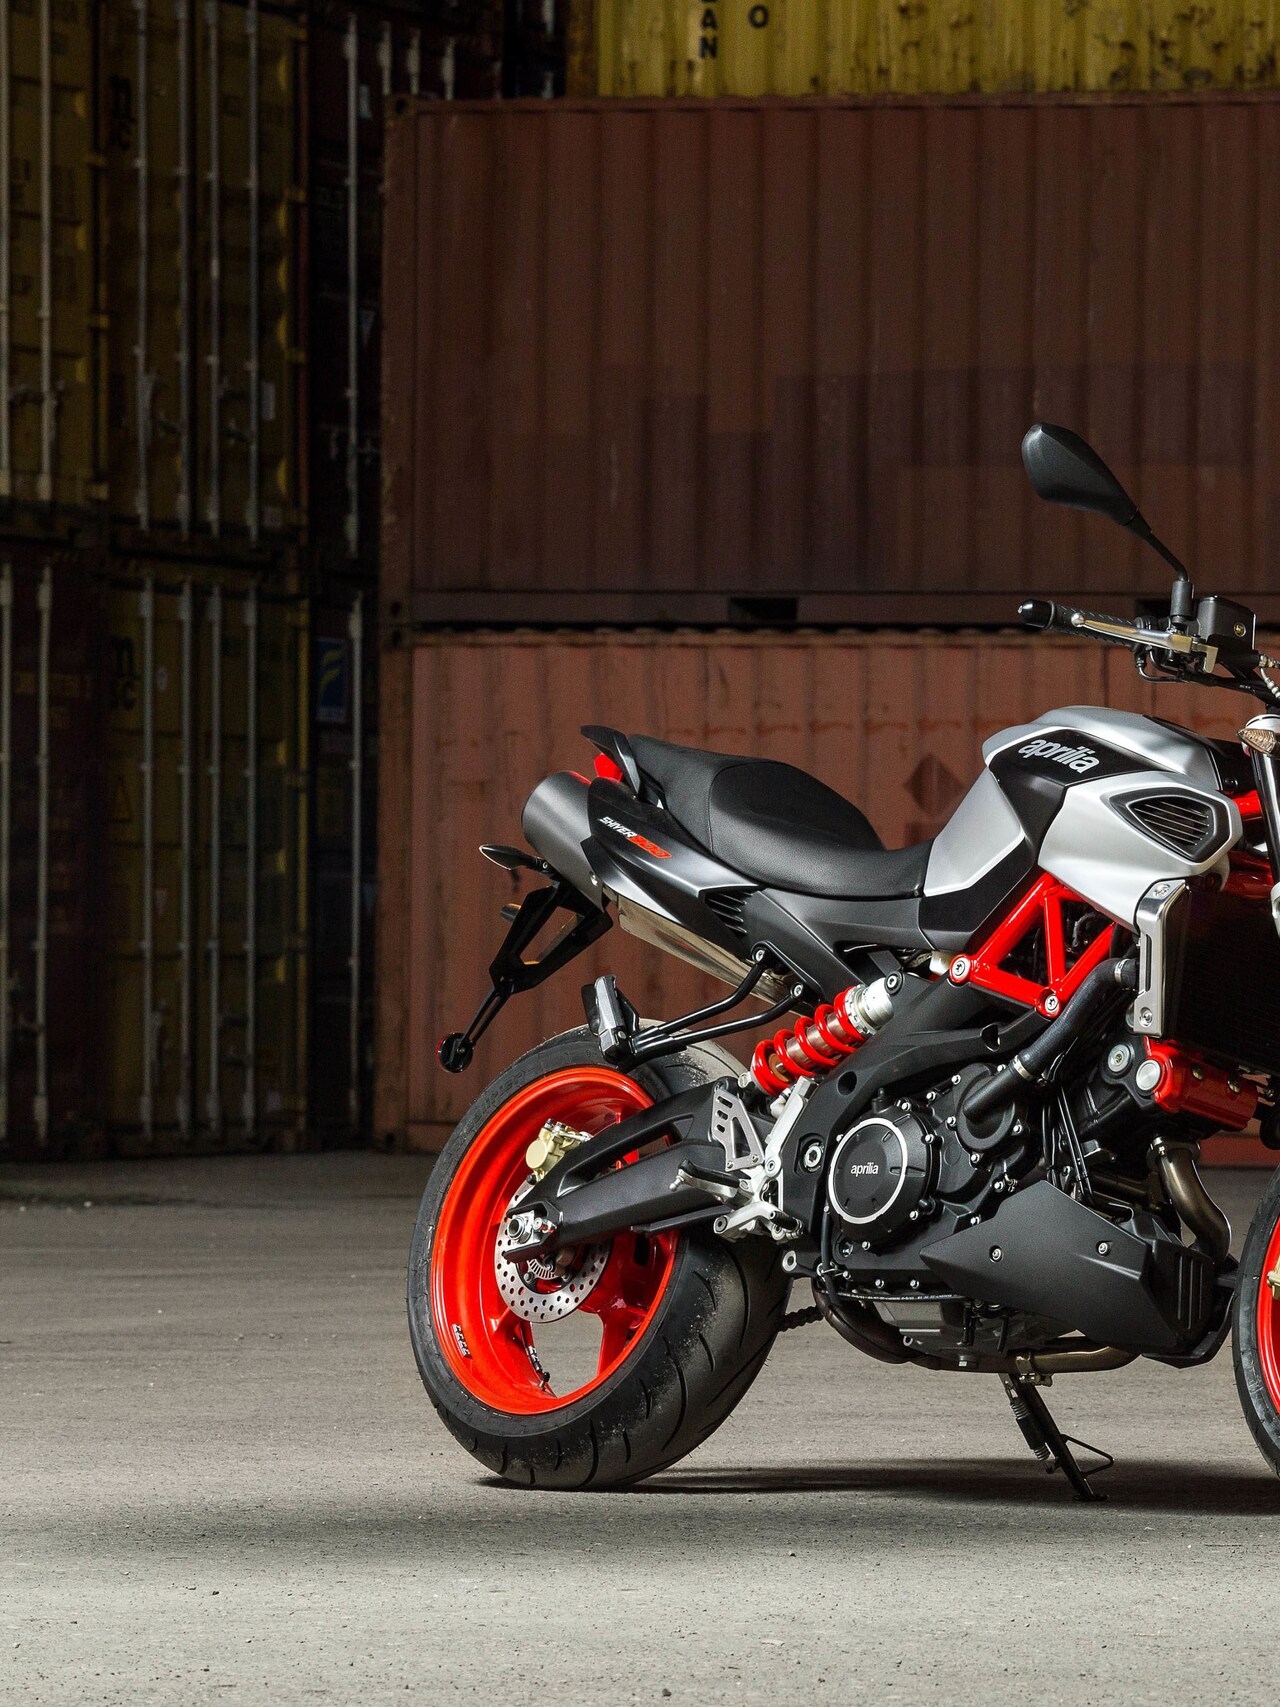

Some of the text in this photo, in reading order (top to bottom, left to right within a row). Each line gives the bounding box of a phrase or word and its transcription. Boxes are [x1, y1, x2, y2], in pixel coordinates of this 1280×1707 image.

[700, 0, 718, 58] AN
[1018, 739, 1099, 774] aprilia
[599, 816, 672, 858] SHIVER 900
[850, 1161, 879, 1178] aprilia
